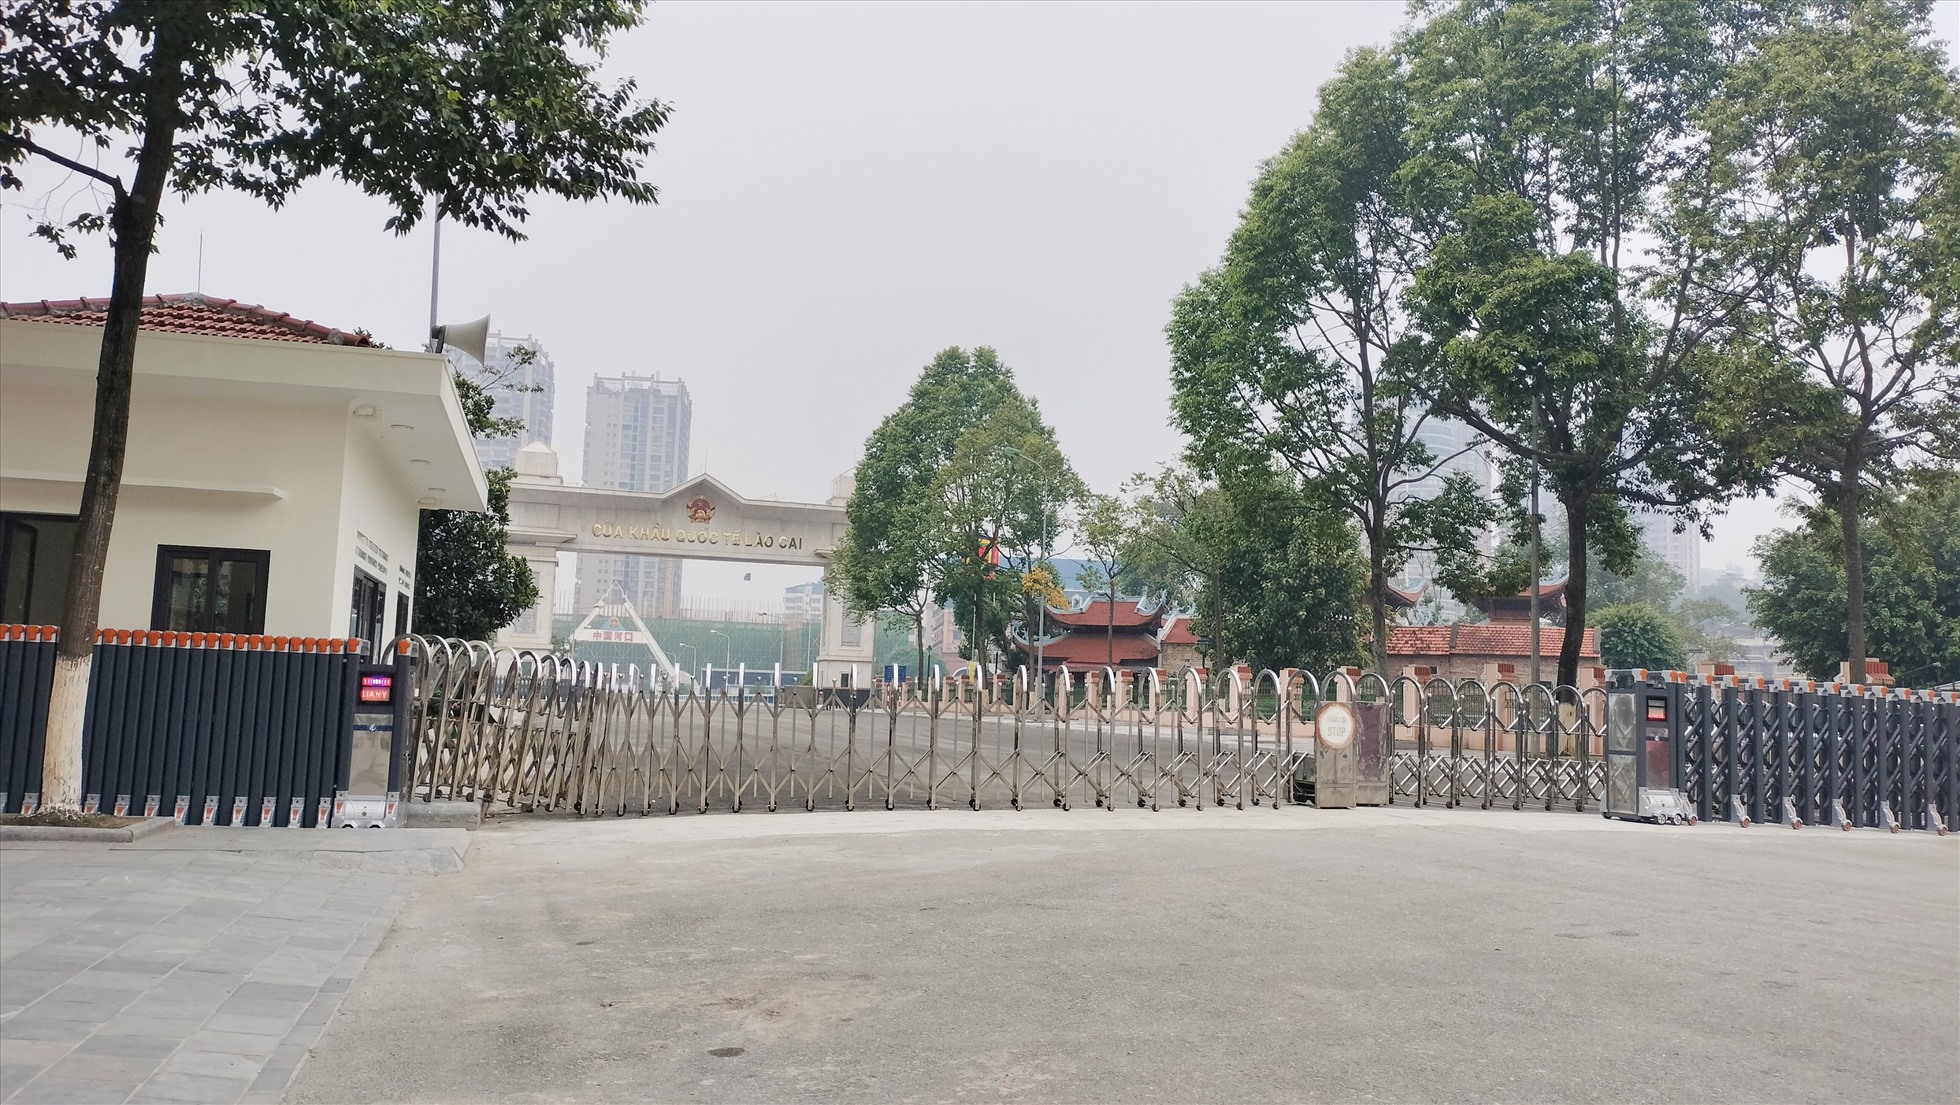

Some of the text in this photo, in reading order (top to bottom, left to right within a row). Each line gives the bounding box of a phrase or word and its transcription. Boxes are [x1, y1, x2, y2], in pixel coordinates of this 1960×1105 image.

[629, 522, 671, 542] KHẨU
[676, 527, 719, 545] QUỐC
[723, 528, 742, 546] TẾ
[745, 532, 774, 548] LÀO
[778, 536, 803, 550] CAI
[1327, 726, 1346, 737] STOP
